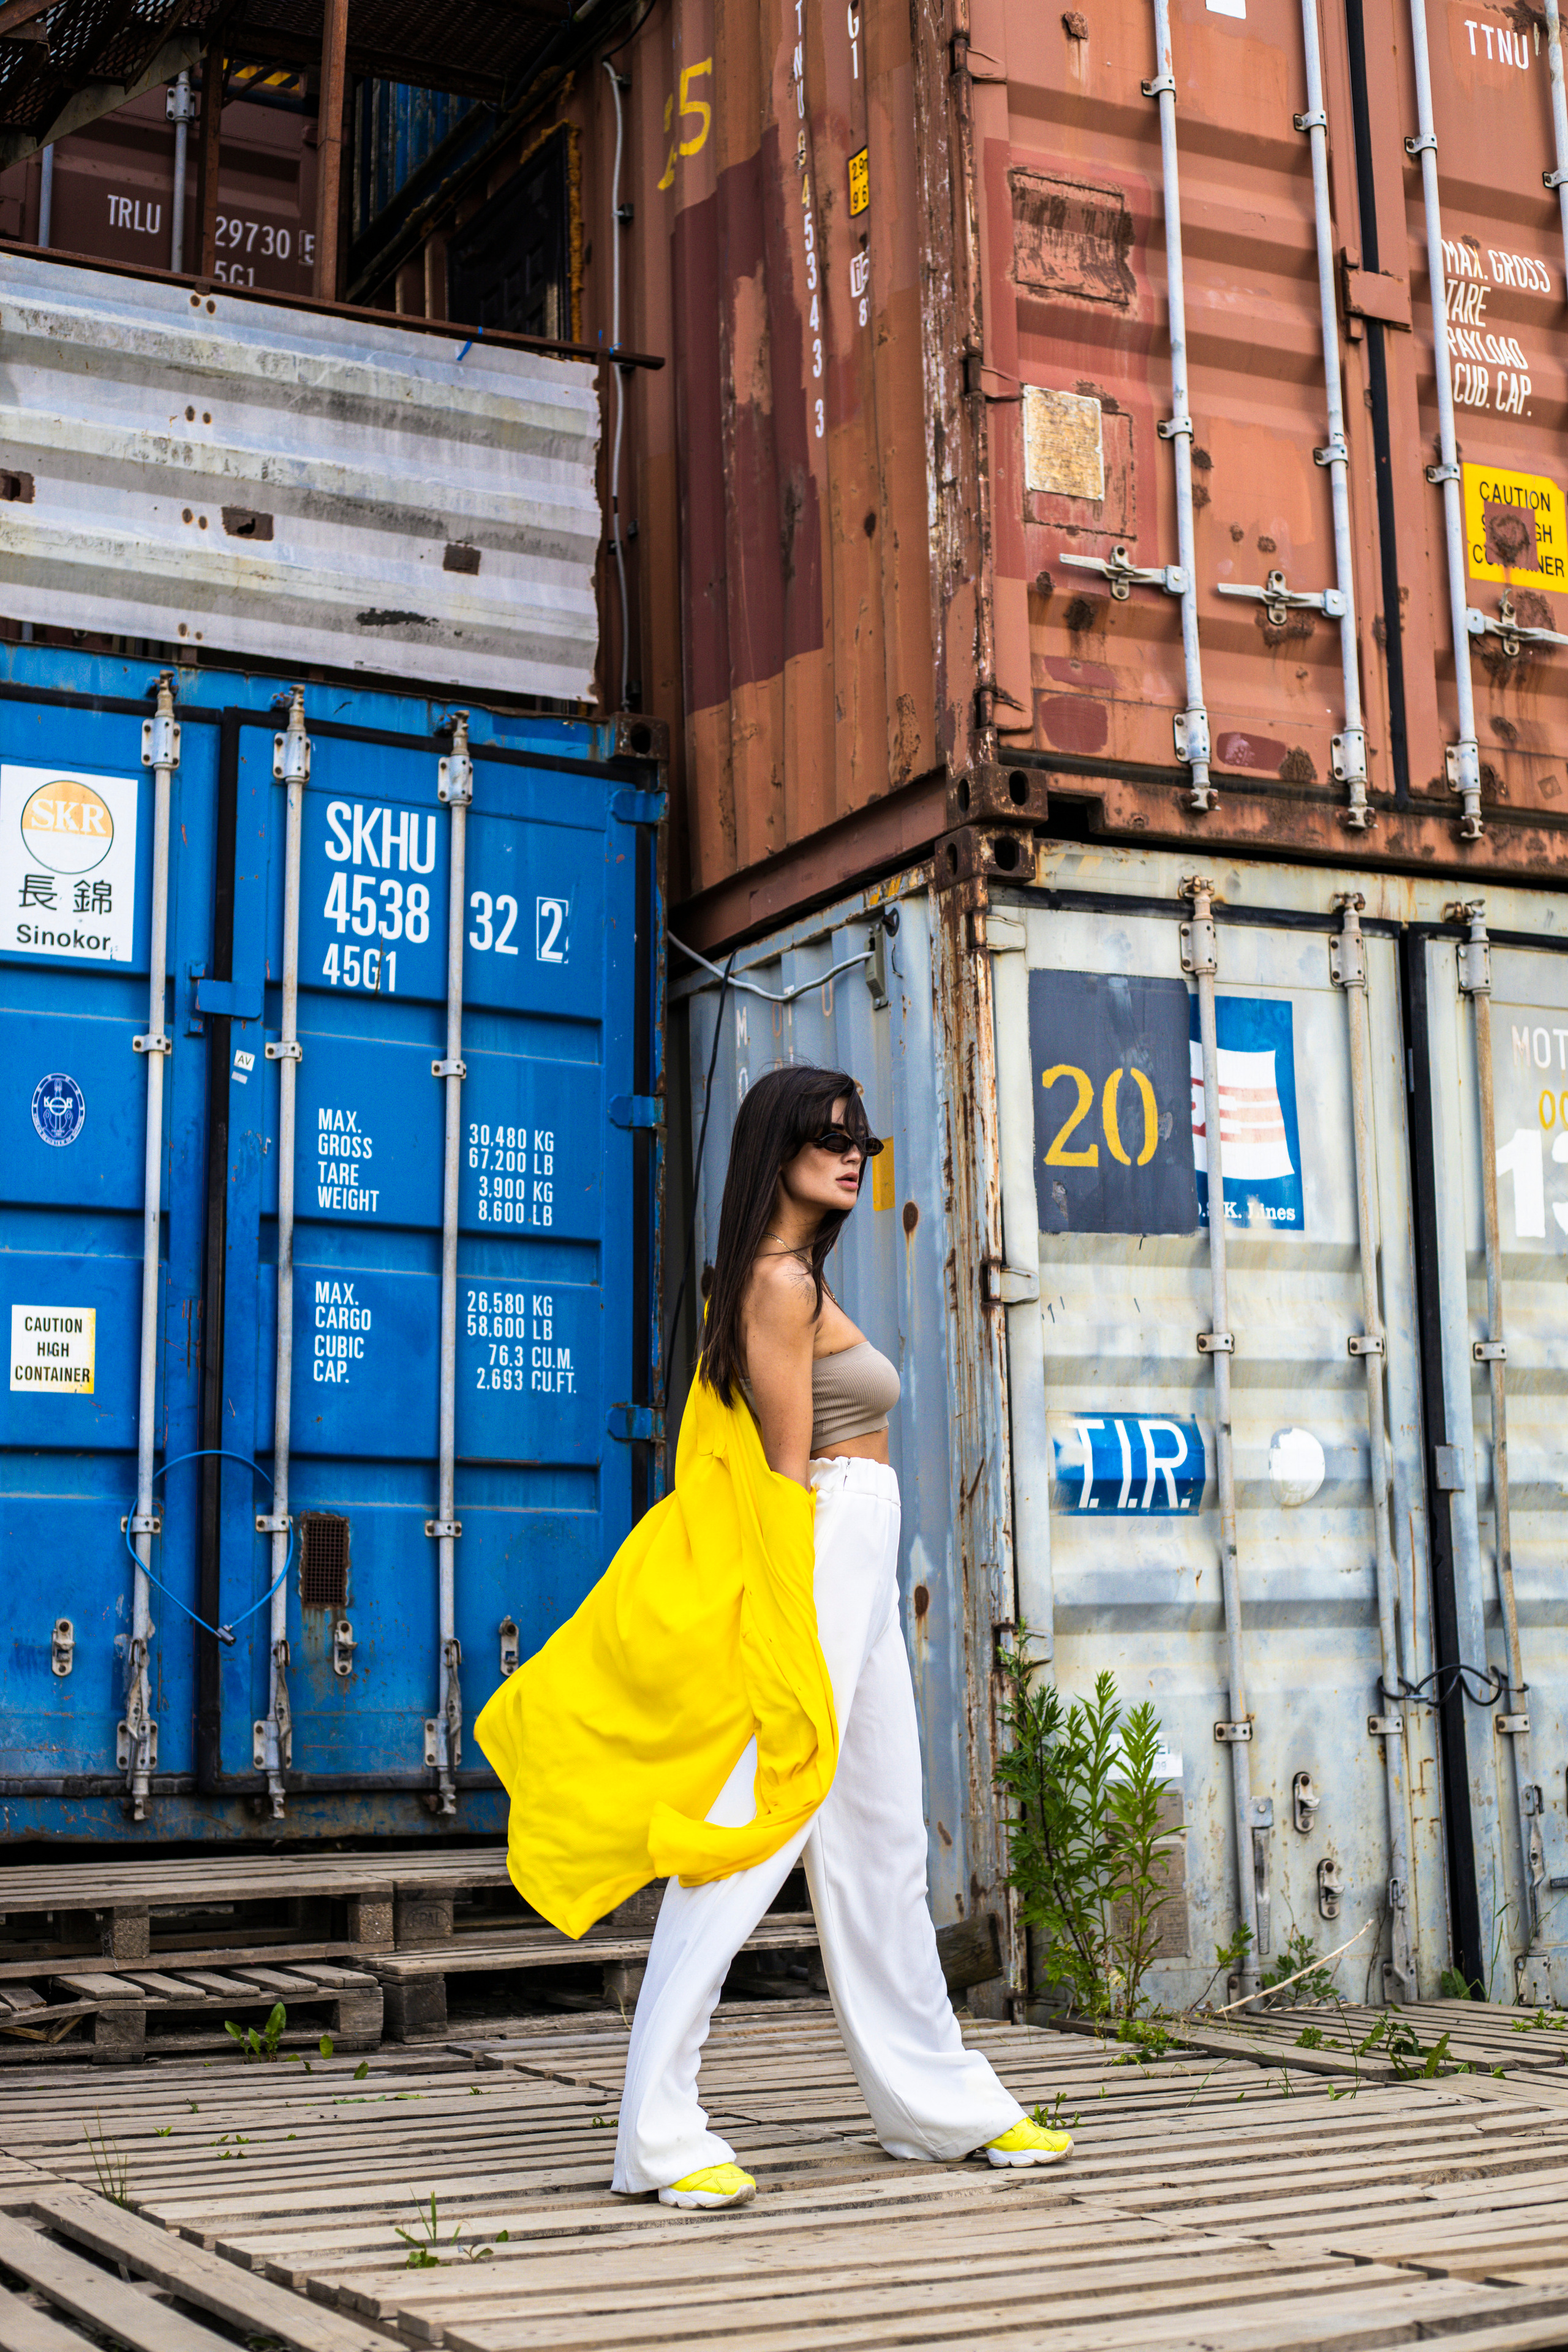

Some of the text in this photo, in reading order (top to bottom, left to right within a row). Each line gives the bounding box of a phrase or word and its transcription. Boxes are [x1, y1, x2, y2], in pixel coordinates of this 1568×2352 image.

[1464, 20, 1529, 70] TTNU
[107, 194, 161, 234] TRLU
[1441, 239, 1551, 293] MAX. GROSS
[1446, 279, 1491, 327] TARE
[1447, 326, 1528, 369] PAYLOAD
[1453, 363, 1532, 416] CUB. CAP.
[1479, 481, 1551, 512] CAUTION
[31, 799, 106, 835] SKR
[325, 801, 436, 874] SKHU
[18, 873, 112, 915] 長錦
[324, 872, 563, 960] 4538 32 2
[17, 924, 111, 950] Sinokor
[322, 943, 396, 992] 45G1
[238, 1055, 251, 1066] AV
[318, 1108, 362, 1133] MAX.
[1042, 1064, 1159, 1167] 20
[318, 1134, 372, 1159] GROSS
[469, 1124, 554, 1152] 30,480 KG
[318, 1161, 359, 1186] TARE
[469, 1147, 553, 1175] 67,200 LB
[318, 1186, 379, 1212] WEIGHT
[479, 1176, 553, 1203] 3,900 KG
[478, 1200, 552, 1226] 8,600 LB
[1247, 1202, 1296, 1221] Lines
[315, 1281, 359, 1305] MAX.
[467, 1291, 552, 1317] 26,580 KG
[25, 1316, 82, 1333] CAUTION
[315, 1306, 371, 1330] CARGO
[467, 1314, 552, 1340] 58,600 LB
[37, 1341, 69, 1357] HIGH
[315, 1335, 364, 1359] CUBIC
[489, 1344, 574, 1370] 76.3 CU.M.
[15, 1365, 90, 1382] CONTAINER
[314, 1360, 349, 1384] CAP.
[477, 1367, 523, 1391] 2,693
